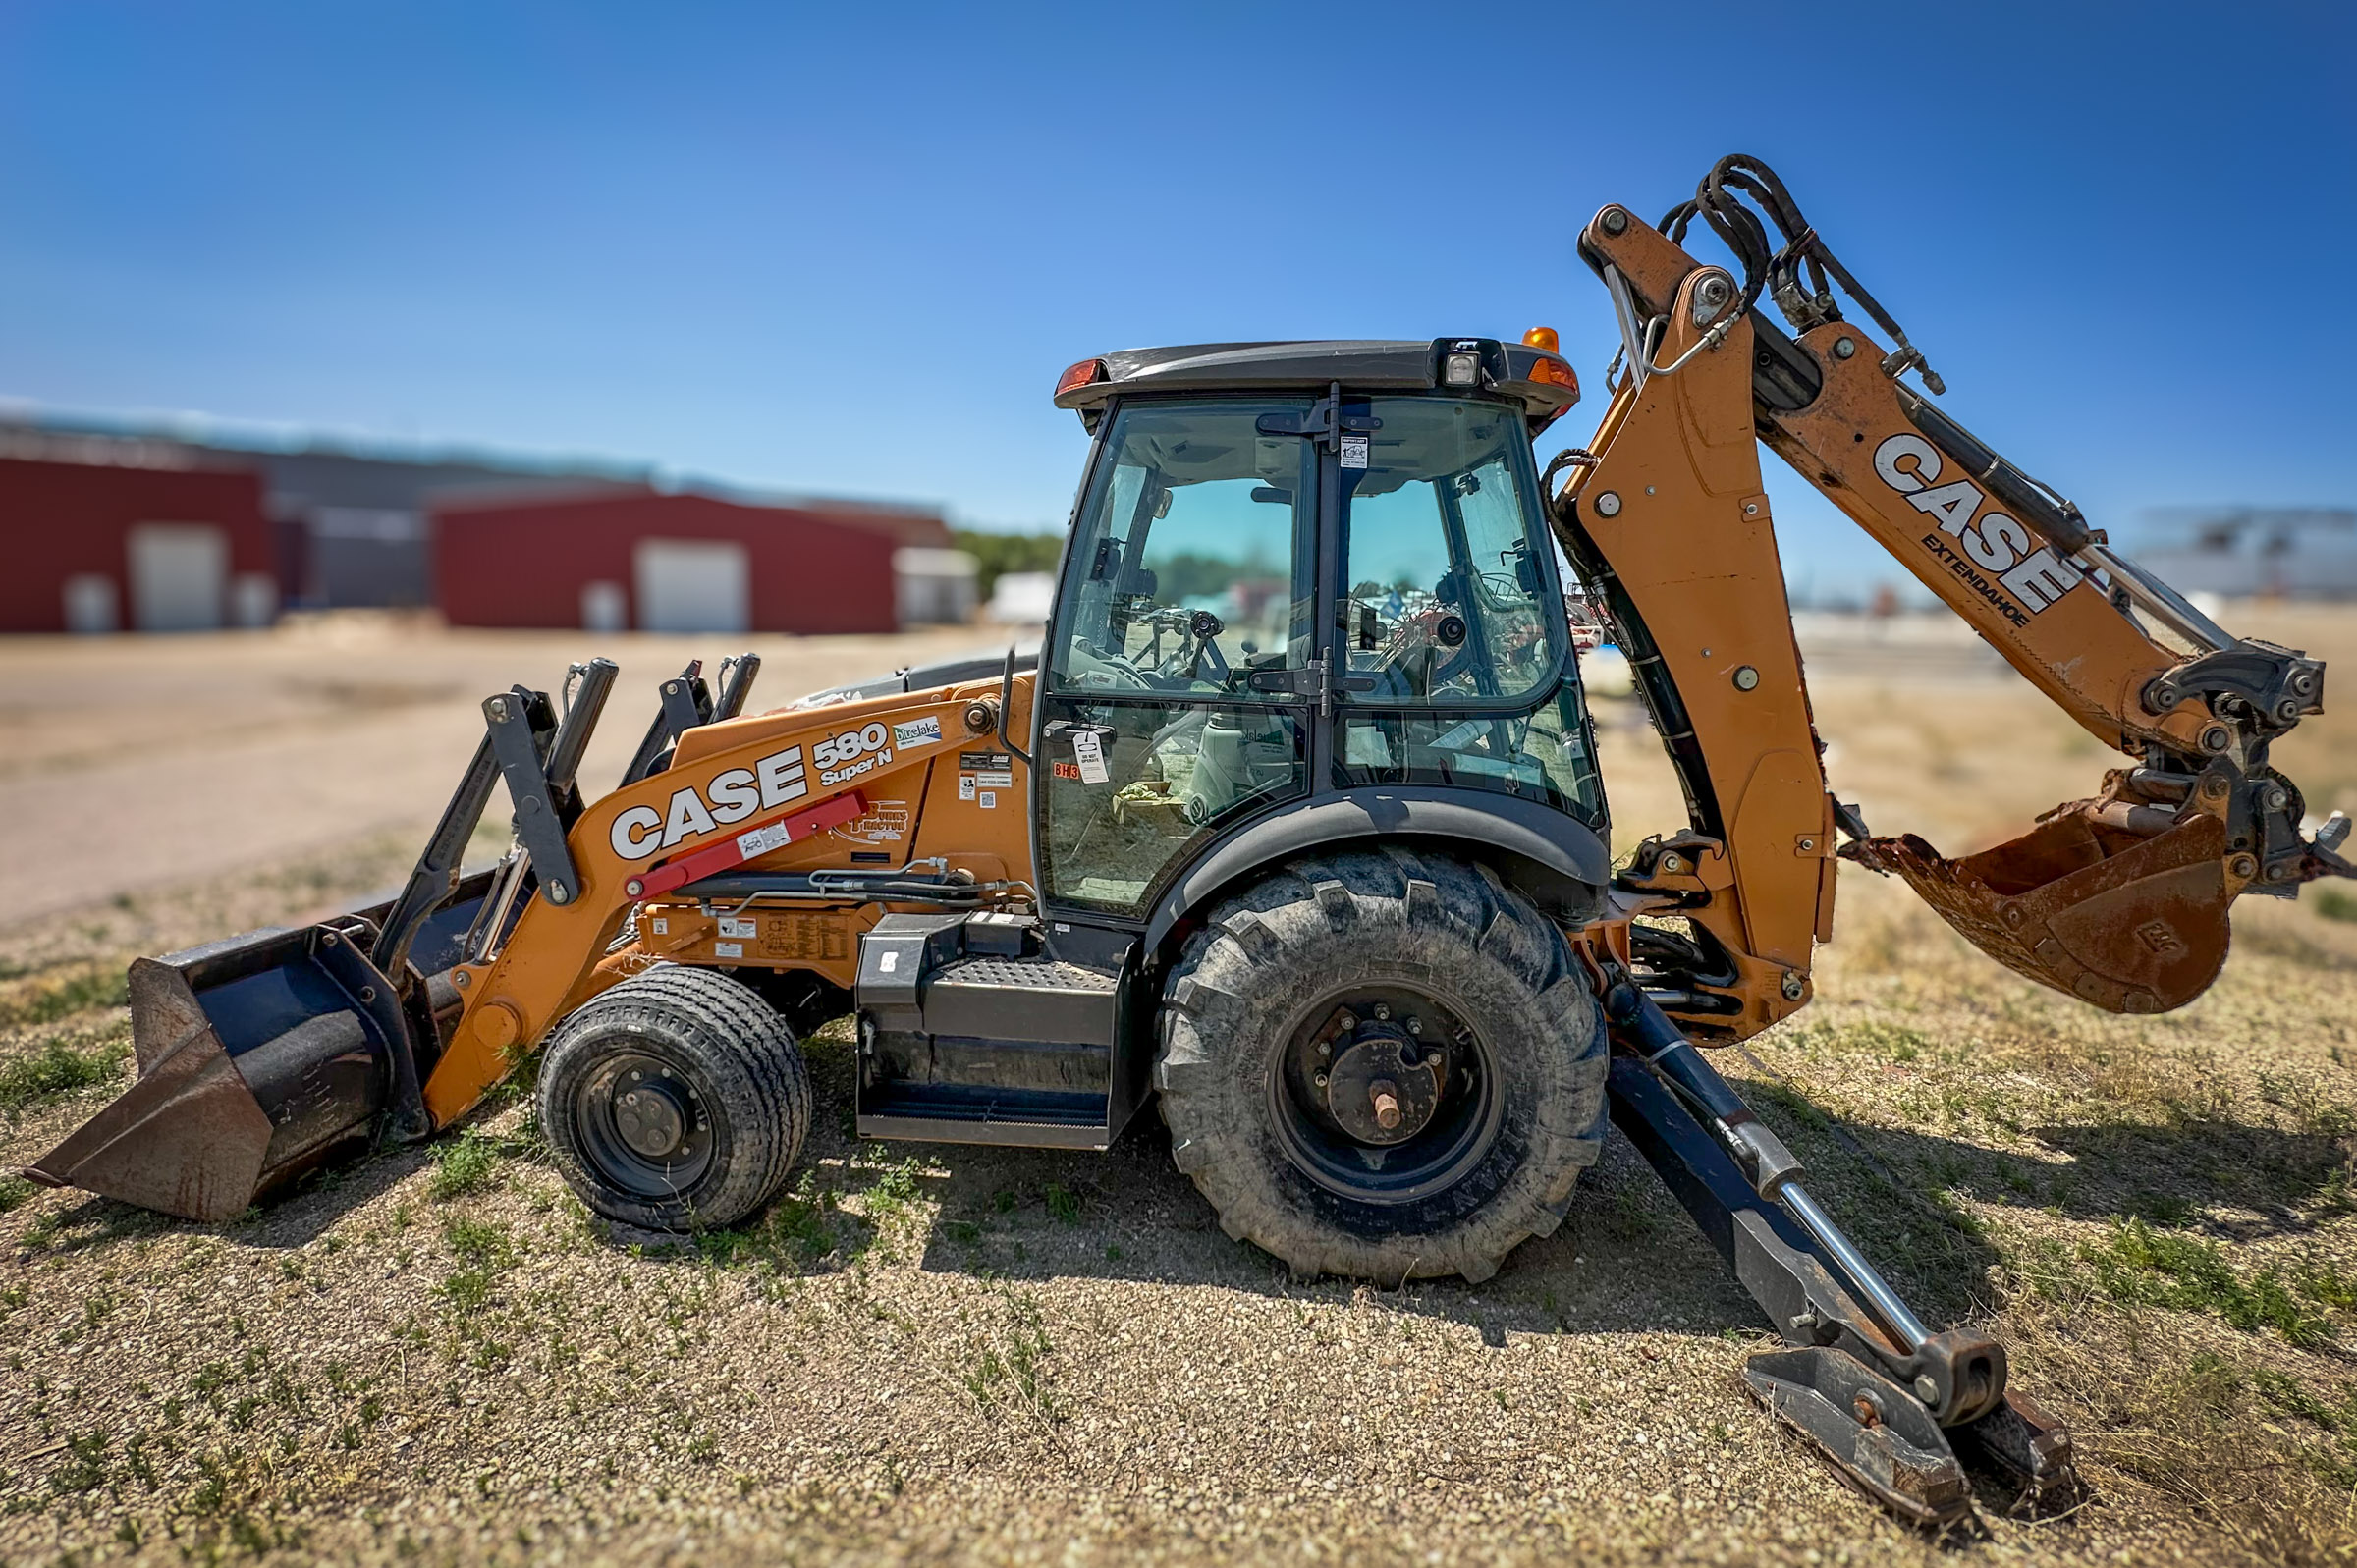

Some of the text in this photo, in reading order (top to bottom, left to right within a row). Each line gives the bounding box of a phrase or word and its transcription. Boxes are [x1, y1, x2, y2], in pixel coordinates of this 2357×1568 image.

[1873, 432, 2083, 615] CASE
[1921, 533, 2031, 628] EXTENDAHOE
[812, 722, 888, 770] 580
[820, 747, 893, 786] Super N
[610, 744, 808, 860] CASE
